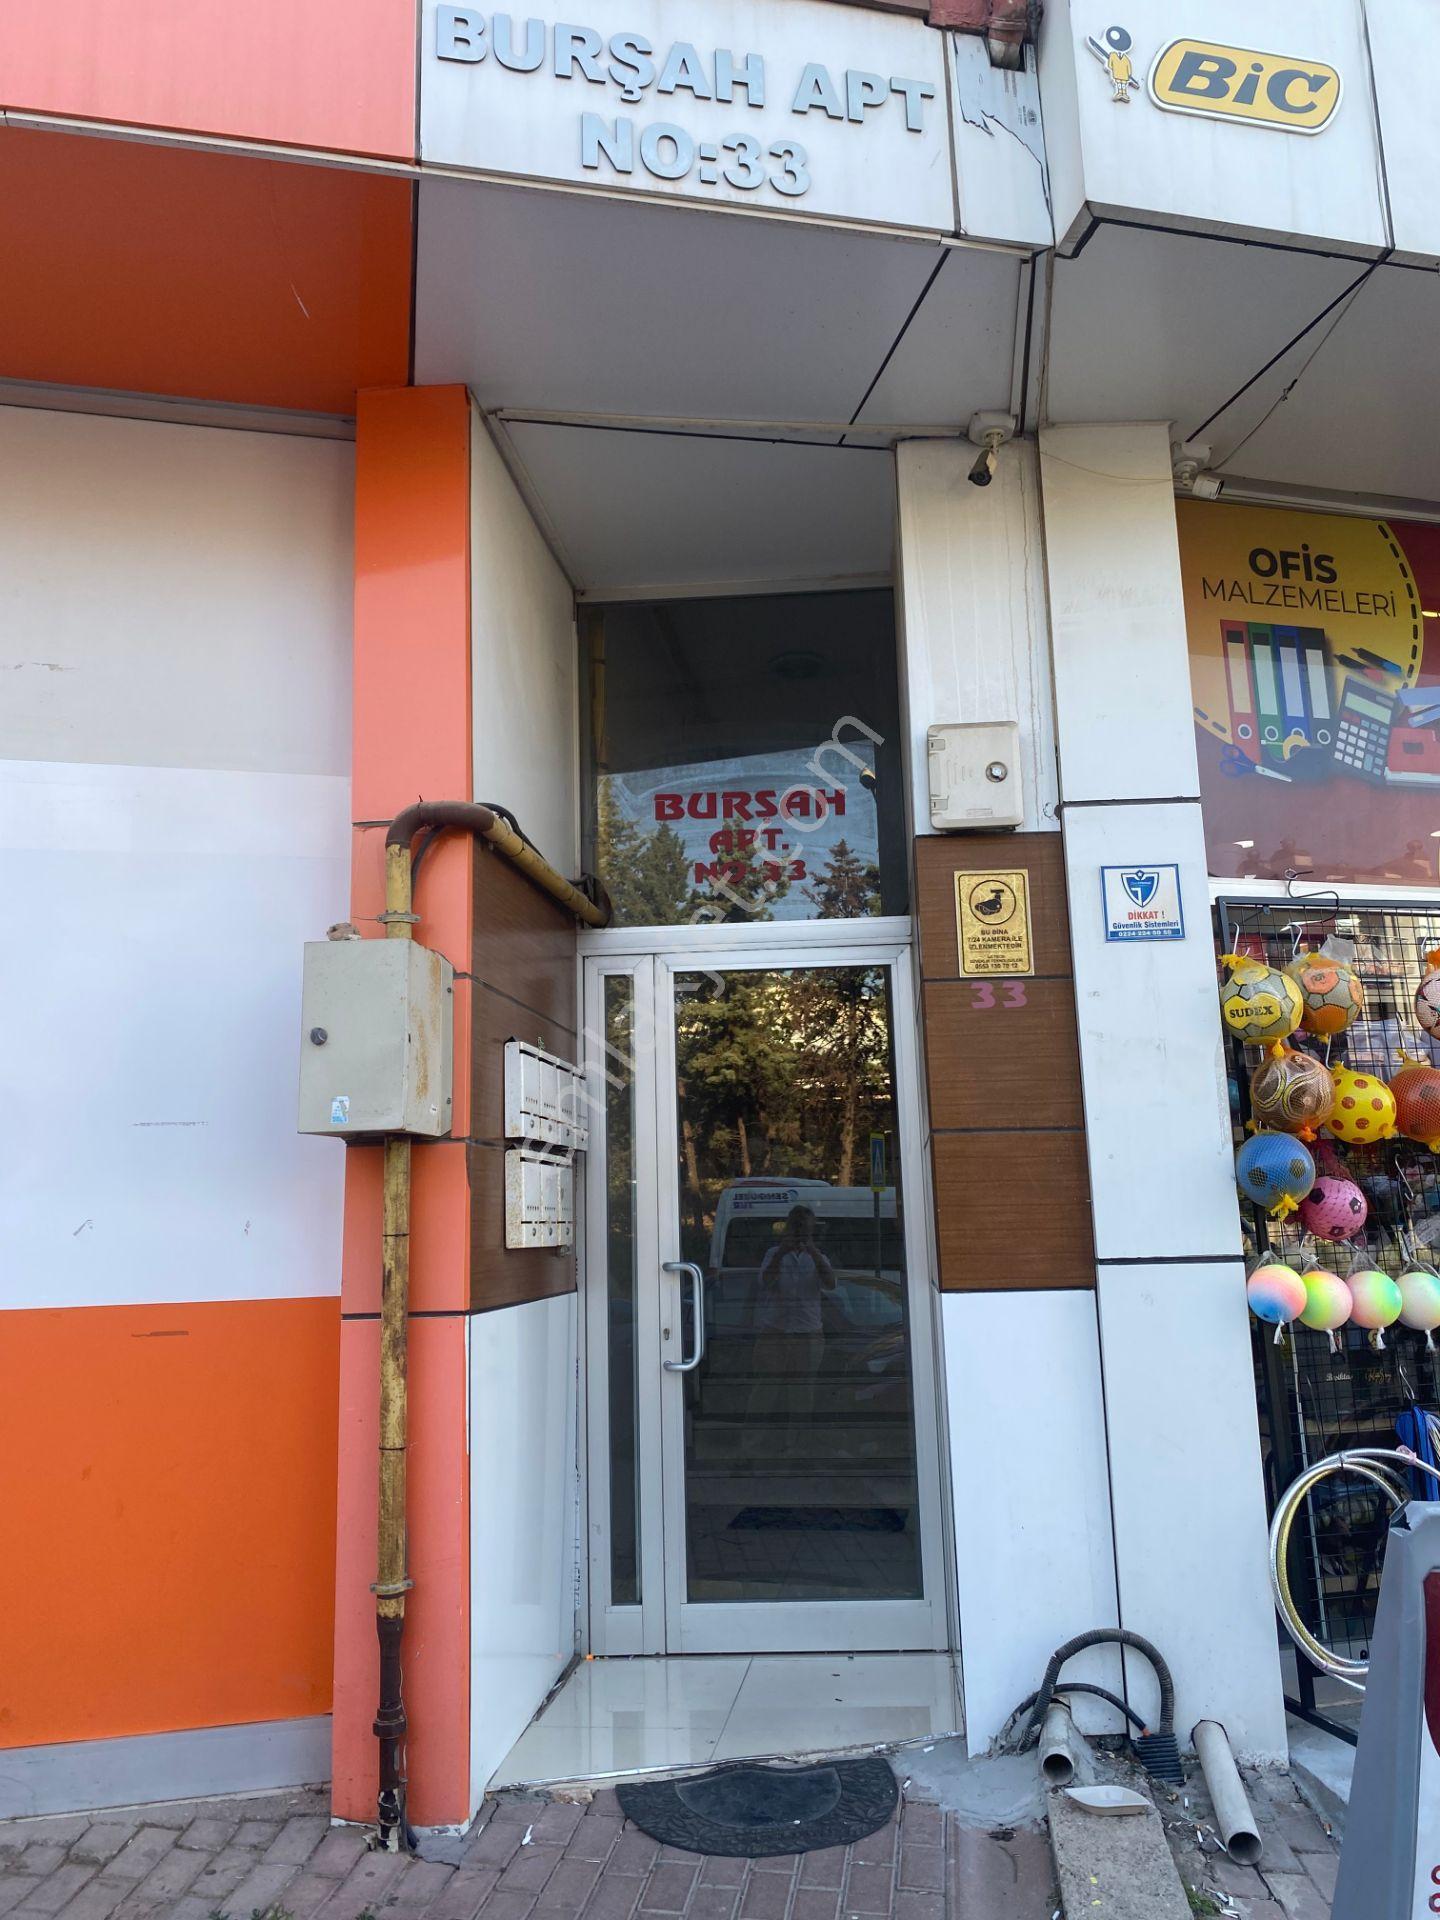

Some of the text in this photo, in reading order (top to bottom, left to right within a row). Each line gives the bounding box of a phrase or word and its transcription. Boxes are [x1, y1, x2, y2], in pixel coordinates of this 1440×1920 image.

[437, 5, 935, 133] BURŞAH APT
[581, 112, 812, 197] NO:33
[1248, 543, 1337, 584] OFİS
[1202, 577, 1396, 617] MALZEMELERİ
[709, 828, 790, 854] APT.
[1128, 910, 1159, 920] DİKKAT
[1145, 920, 1179, 929] Sistemleri
[970, 981, 1028, 1008] 33
[1229, 1006, 1274, 1018] SUDEX
